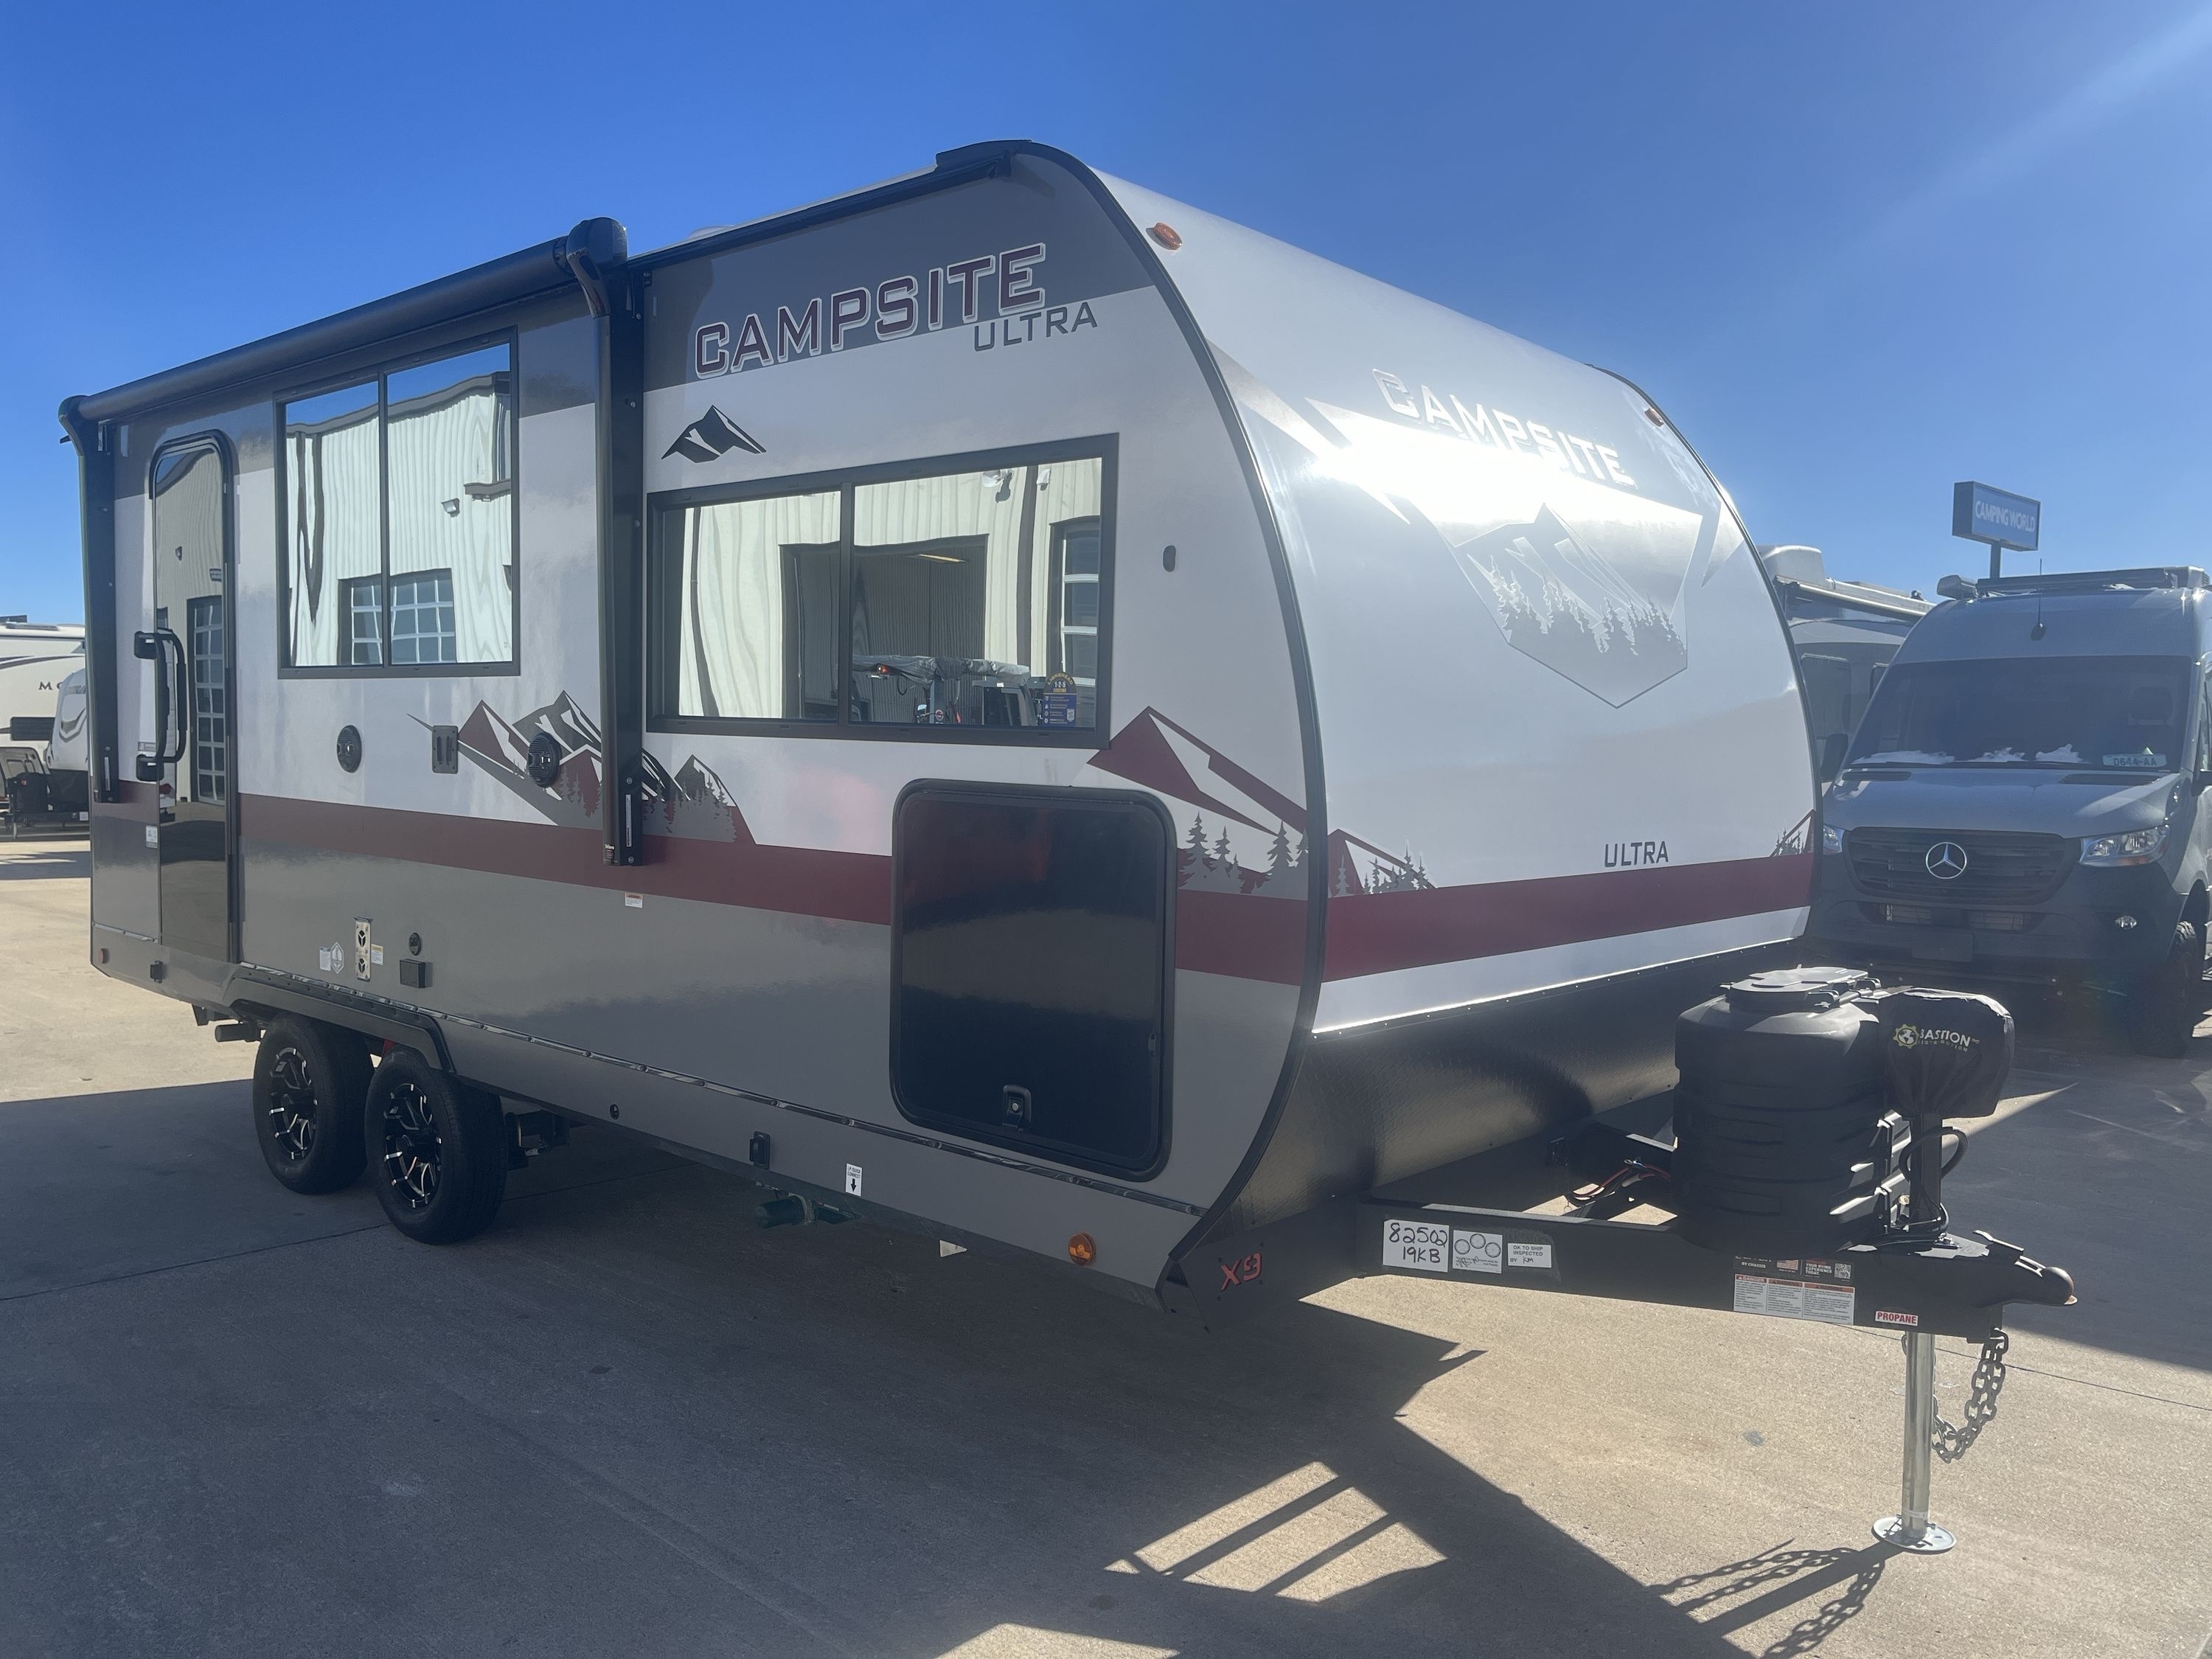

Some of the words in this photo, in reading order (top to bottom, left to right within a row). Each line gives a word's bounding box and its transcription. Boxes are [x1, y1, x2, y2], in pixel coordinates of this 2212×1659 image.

[695, 243, 1046, 379] CAMPSITE
[974, 301, 1098, 352] ULTRA
[1371, 369, 1638, 488] CAMPSITE
[1975, 501, 2009, 526] CAMPING
[2009, 509, 2036, 532] WORLD
[1604, 841, 1669, 867] ULTRA
[1919, 1029, 1971, 1047] BASTION
[1919, 1040, 1968, 1052] ISTRIBUTION
[1389, 1222, 1447, 1248] 82502
[1403, 1246, 1440, 1263] 19KB
[1877, 1312, 1916, 1324] PROPANE
